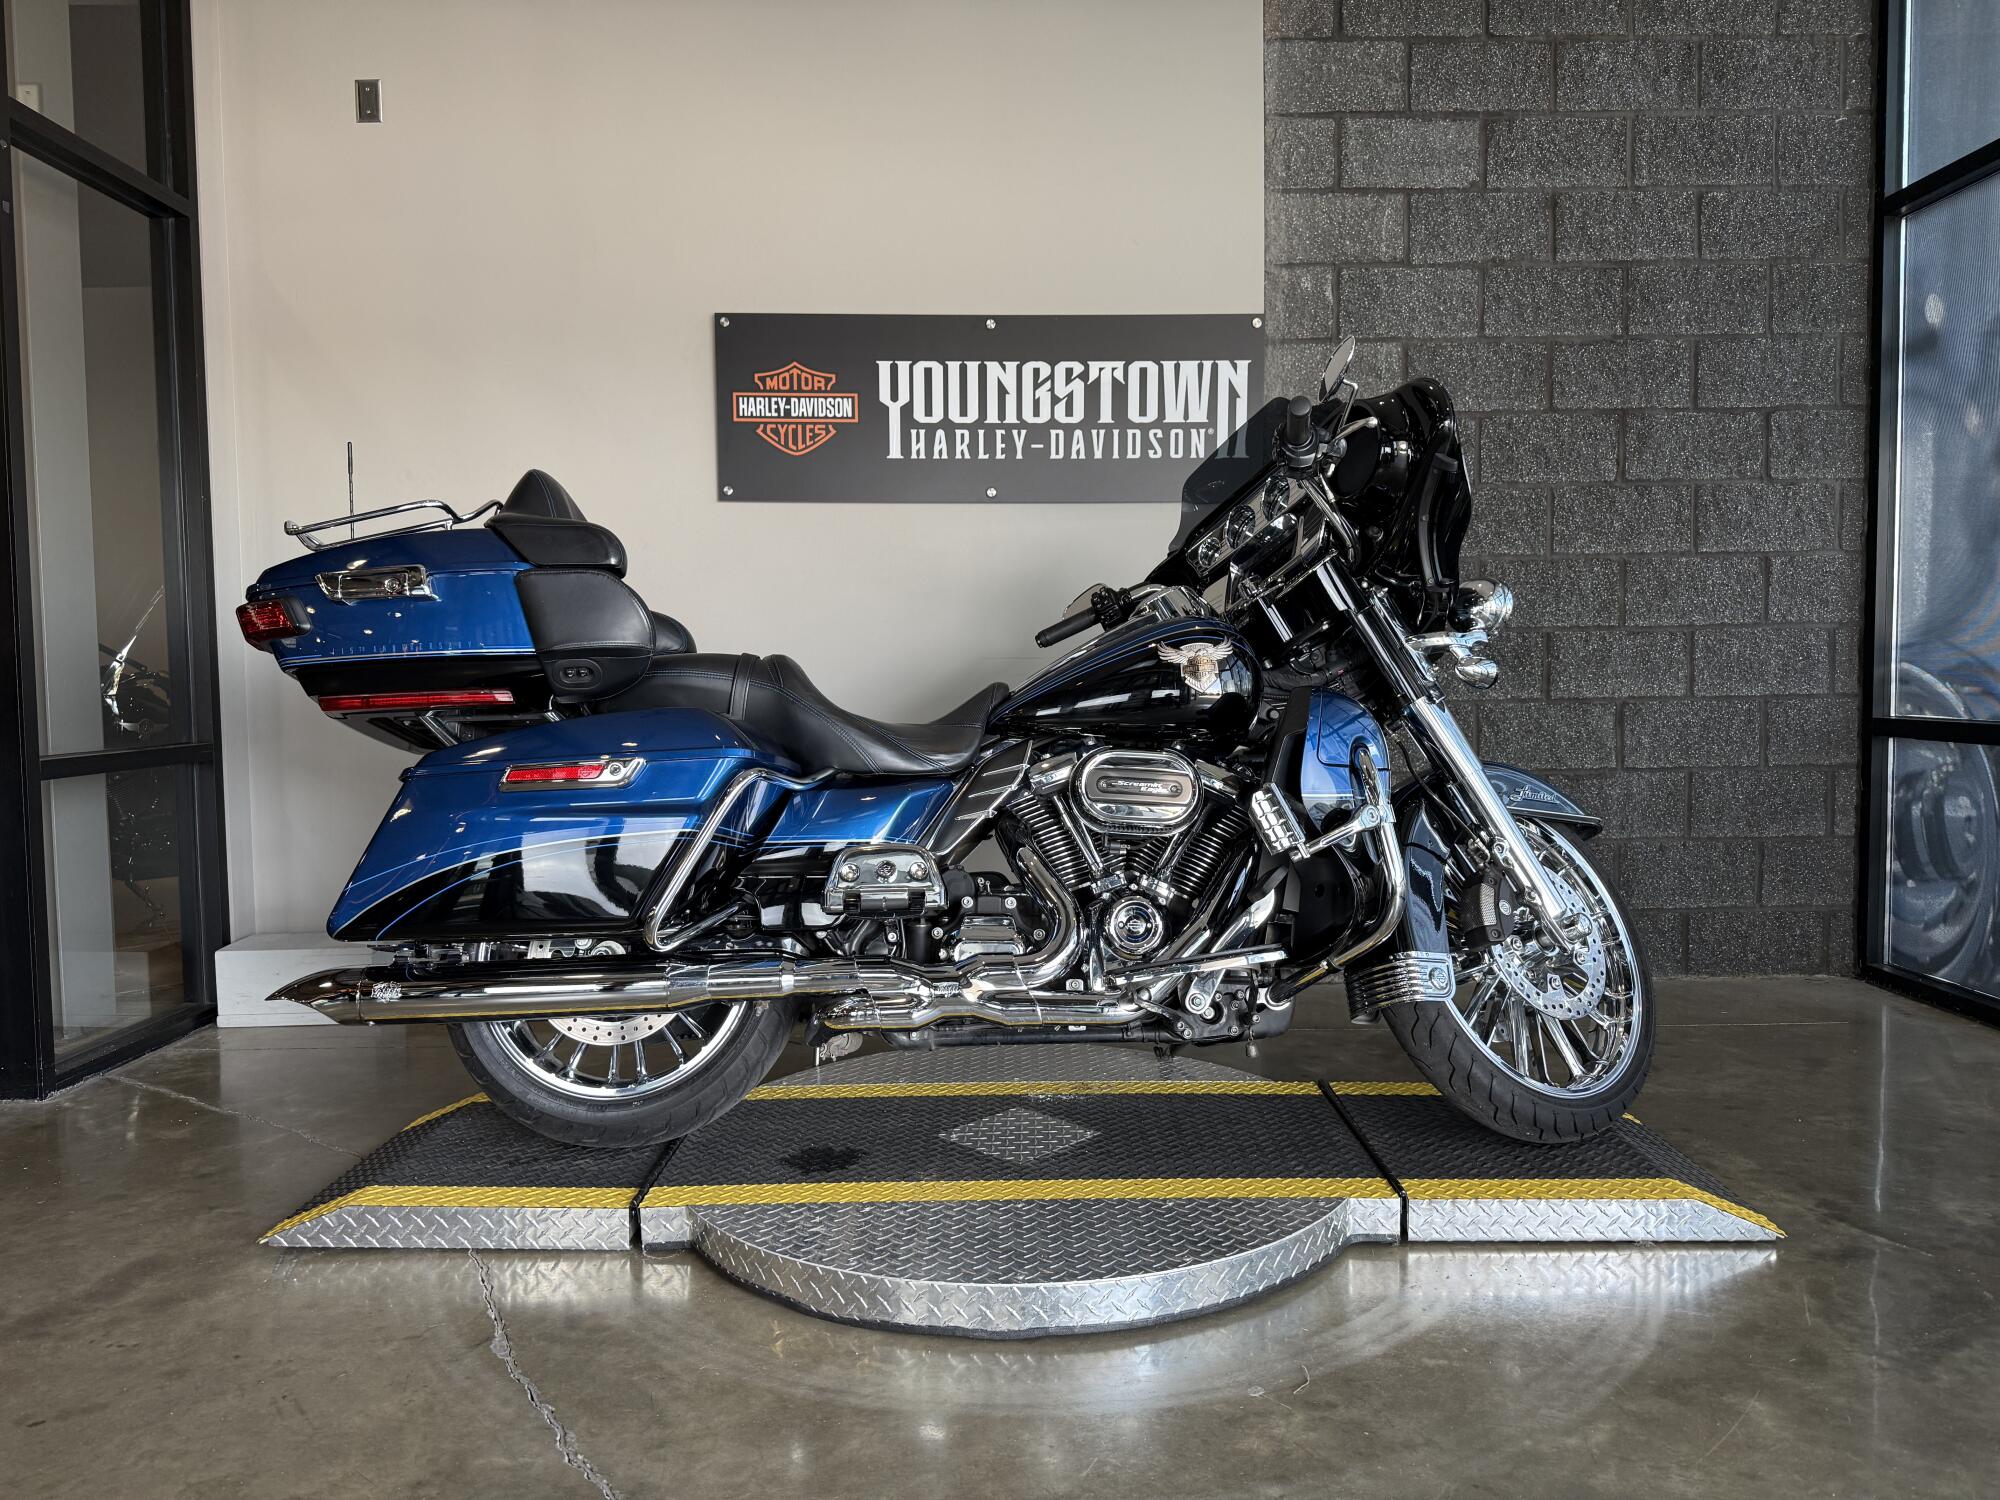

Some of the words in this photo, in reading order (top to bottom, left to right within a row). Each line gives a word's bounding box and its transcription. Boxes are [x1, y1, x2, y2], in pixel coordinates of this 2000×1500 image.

[765, 367, 826, 391] MOTOR
[738, 396, 853, 418] HARLEY-DAVIDSON
[875, 359, 1252, 459] YOUNGSTOWN
[766, 424, 827, 451] CYCLES
[910, 428, 1206, 459] HARLEY-DAVIDSON
[1509, 784, 1560, 804] Limited
